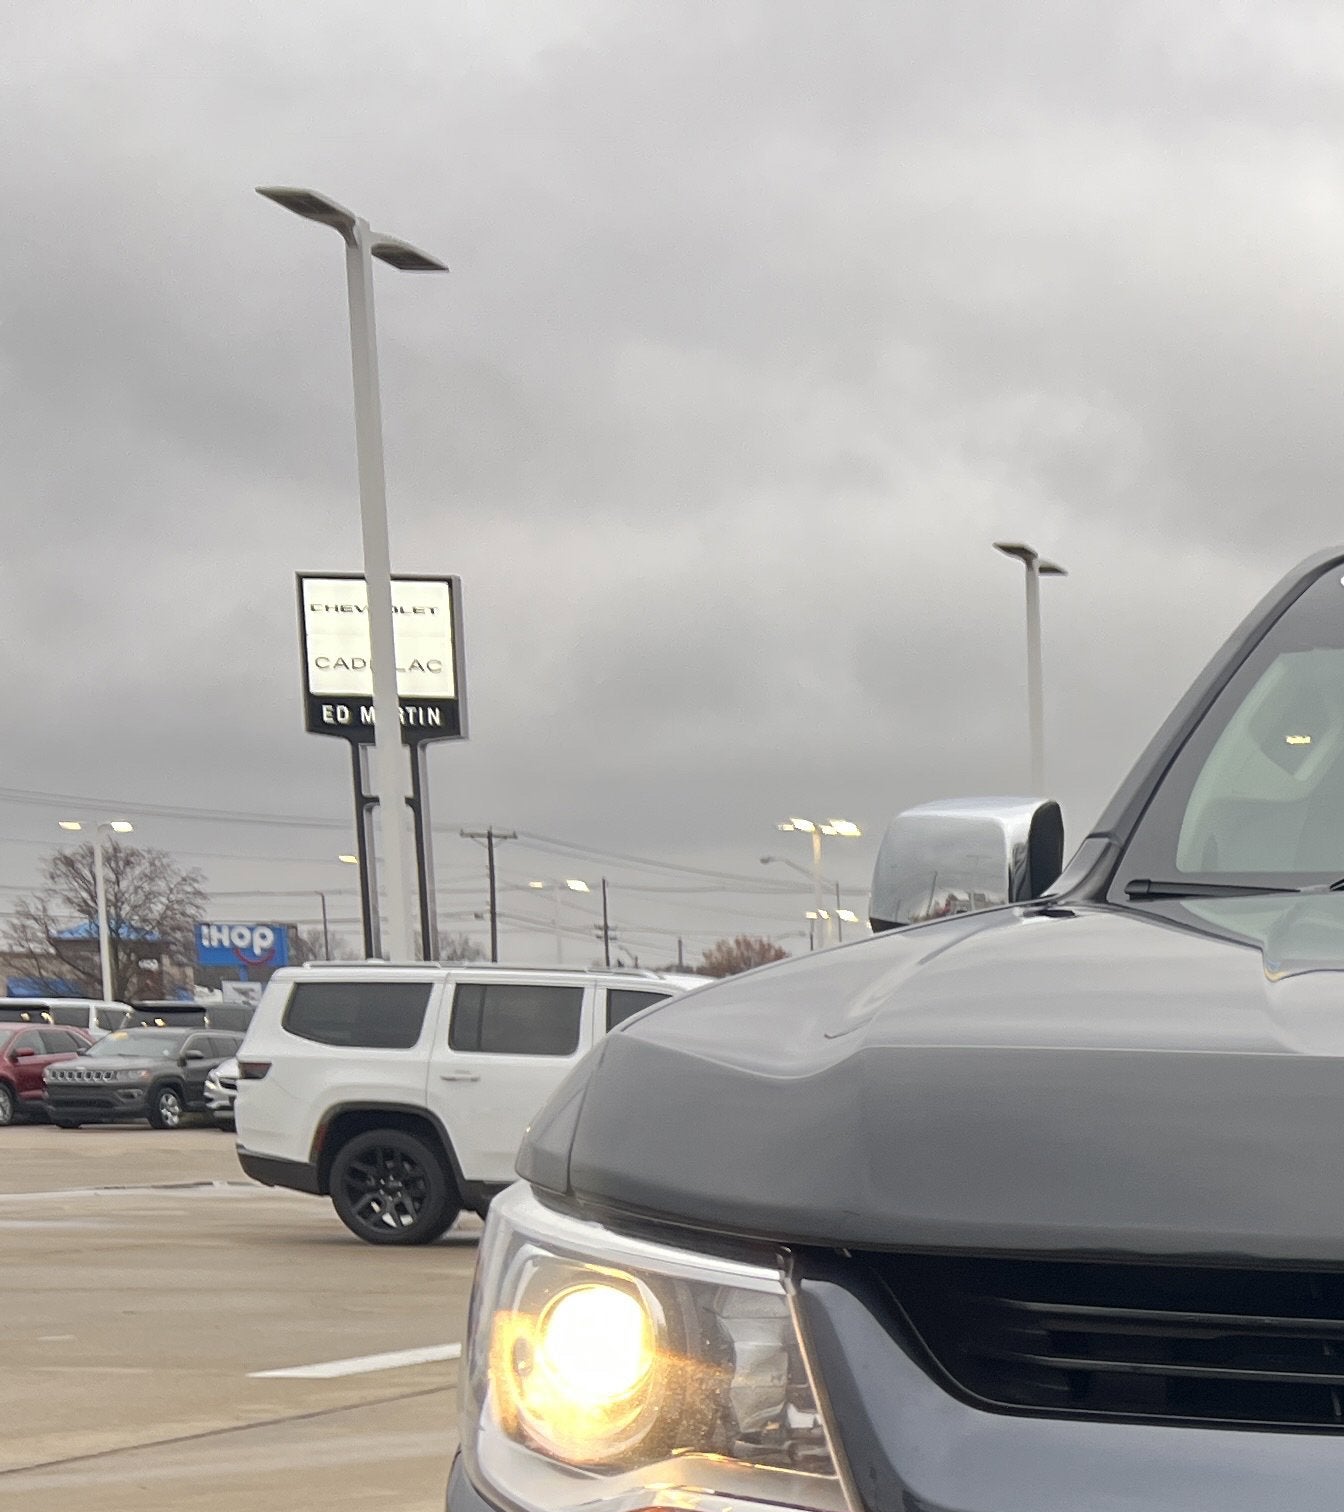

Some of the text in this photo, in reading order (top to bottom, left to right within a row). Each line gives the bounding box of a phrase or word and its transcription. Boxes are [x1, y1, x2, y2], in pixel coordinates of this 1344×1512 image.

[310, 603, 439, 616] CHEVLET
[314, 656, 443, 674] CADAC
[321, 704, 441, 727] ED MTIN
